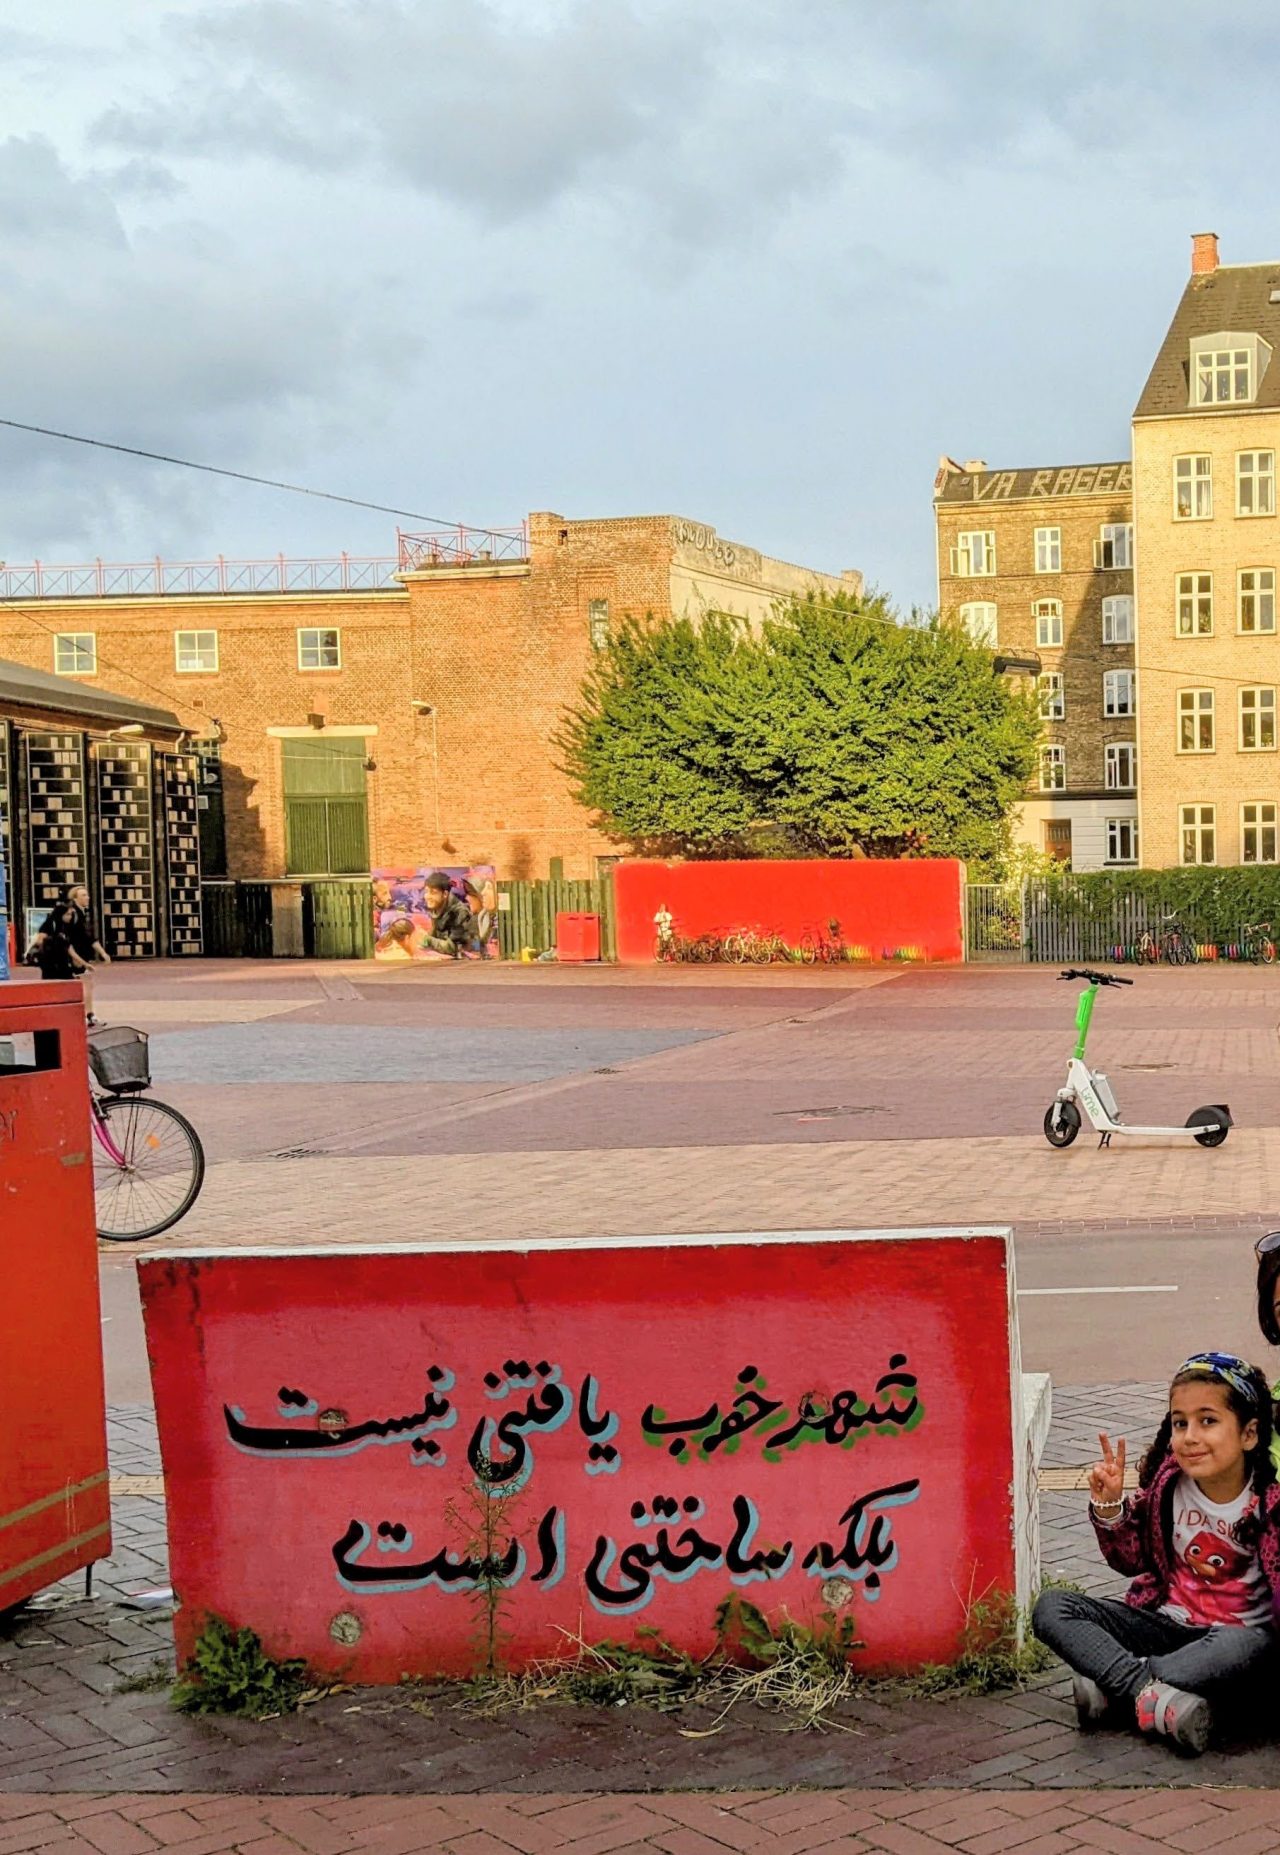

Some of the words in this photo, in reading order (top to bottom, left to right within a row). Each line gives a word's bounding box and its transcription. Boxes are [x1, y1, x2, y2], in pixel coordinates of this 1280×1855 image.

[223, 1365, 457, 1466] نیست
[467, 1359, 622, 1498] یافتنی
[641, 1365, 787, 1462] خوب
[763, 1353, 922, 1460] شهر
[332, 1505, 566, 1594] است
[584, 1494, 796, 1615] ساختنی
[802, 1478, 920, 1602] بلکه
